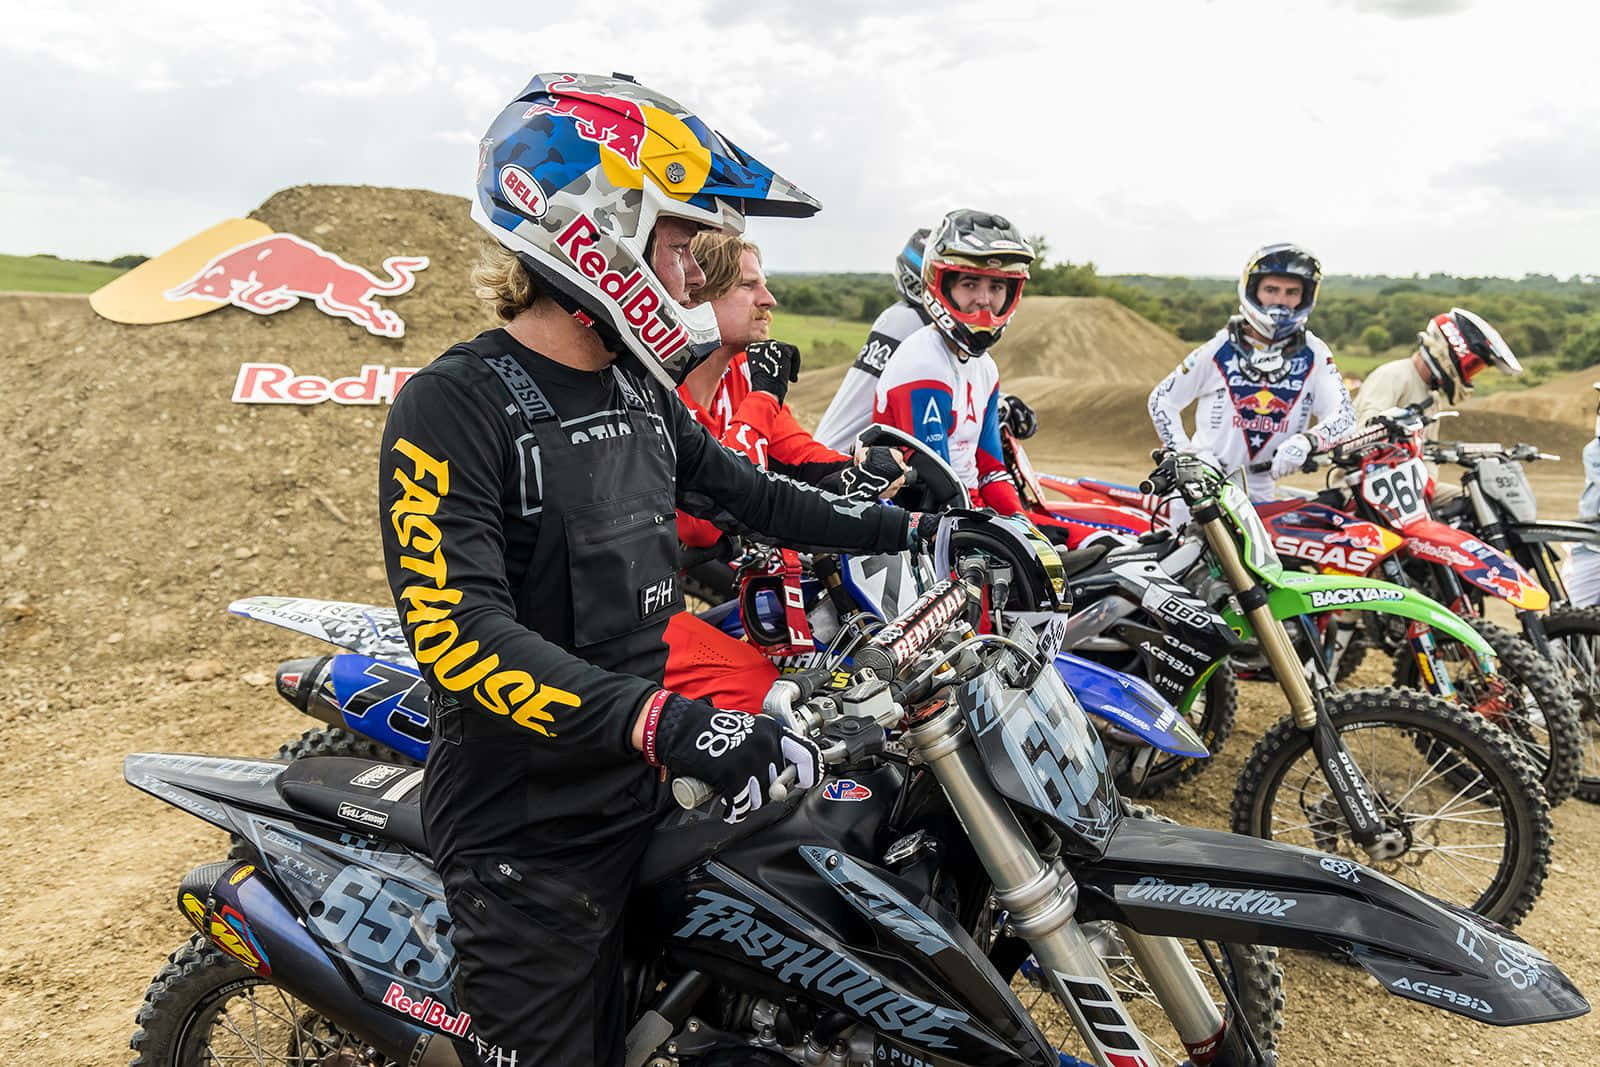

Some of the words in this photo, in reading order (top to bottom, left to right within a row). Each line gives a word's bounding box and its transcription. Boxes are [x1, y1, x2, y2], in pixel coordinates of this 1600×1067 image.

[503, 170, 538, 214] BELL
[556, 213, 643, 301] Red
[622, 284, 689, 361] Bull
[239, 366, 378, 401] Red
[1231, 415, 1261, 431] Red
[1261, 416, 1289, 433] Bull
[1371, 462, 1426, 519] 264
[1270, 535, 1377, 573] SGAS
[389, 436, 582, 738] FASTHOUSE
[643, 577, 673, 615] F/H
[1311, 588, 1404, 608] BACKYARD
[893, 587, 967, 665] RENTHAL
[165, 790, 227, 821] DUNLOP
[1337, 751, 1380, 823] DUNLOP
[673, 889, 971, 1050] FASTHOUSE
[382, 982, 432, 1020] Red
[424, 1000, 472, 1037] Bull
